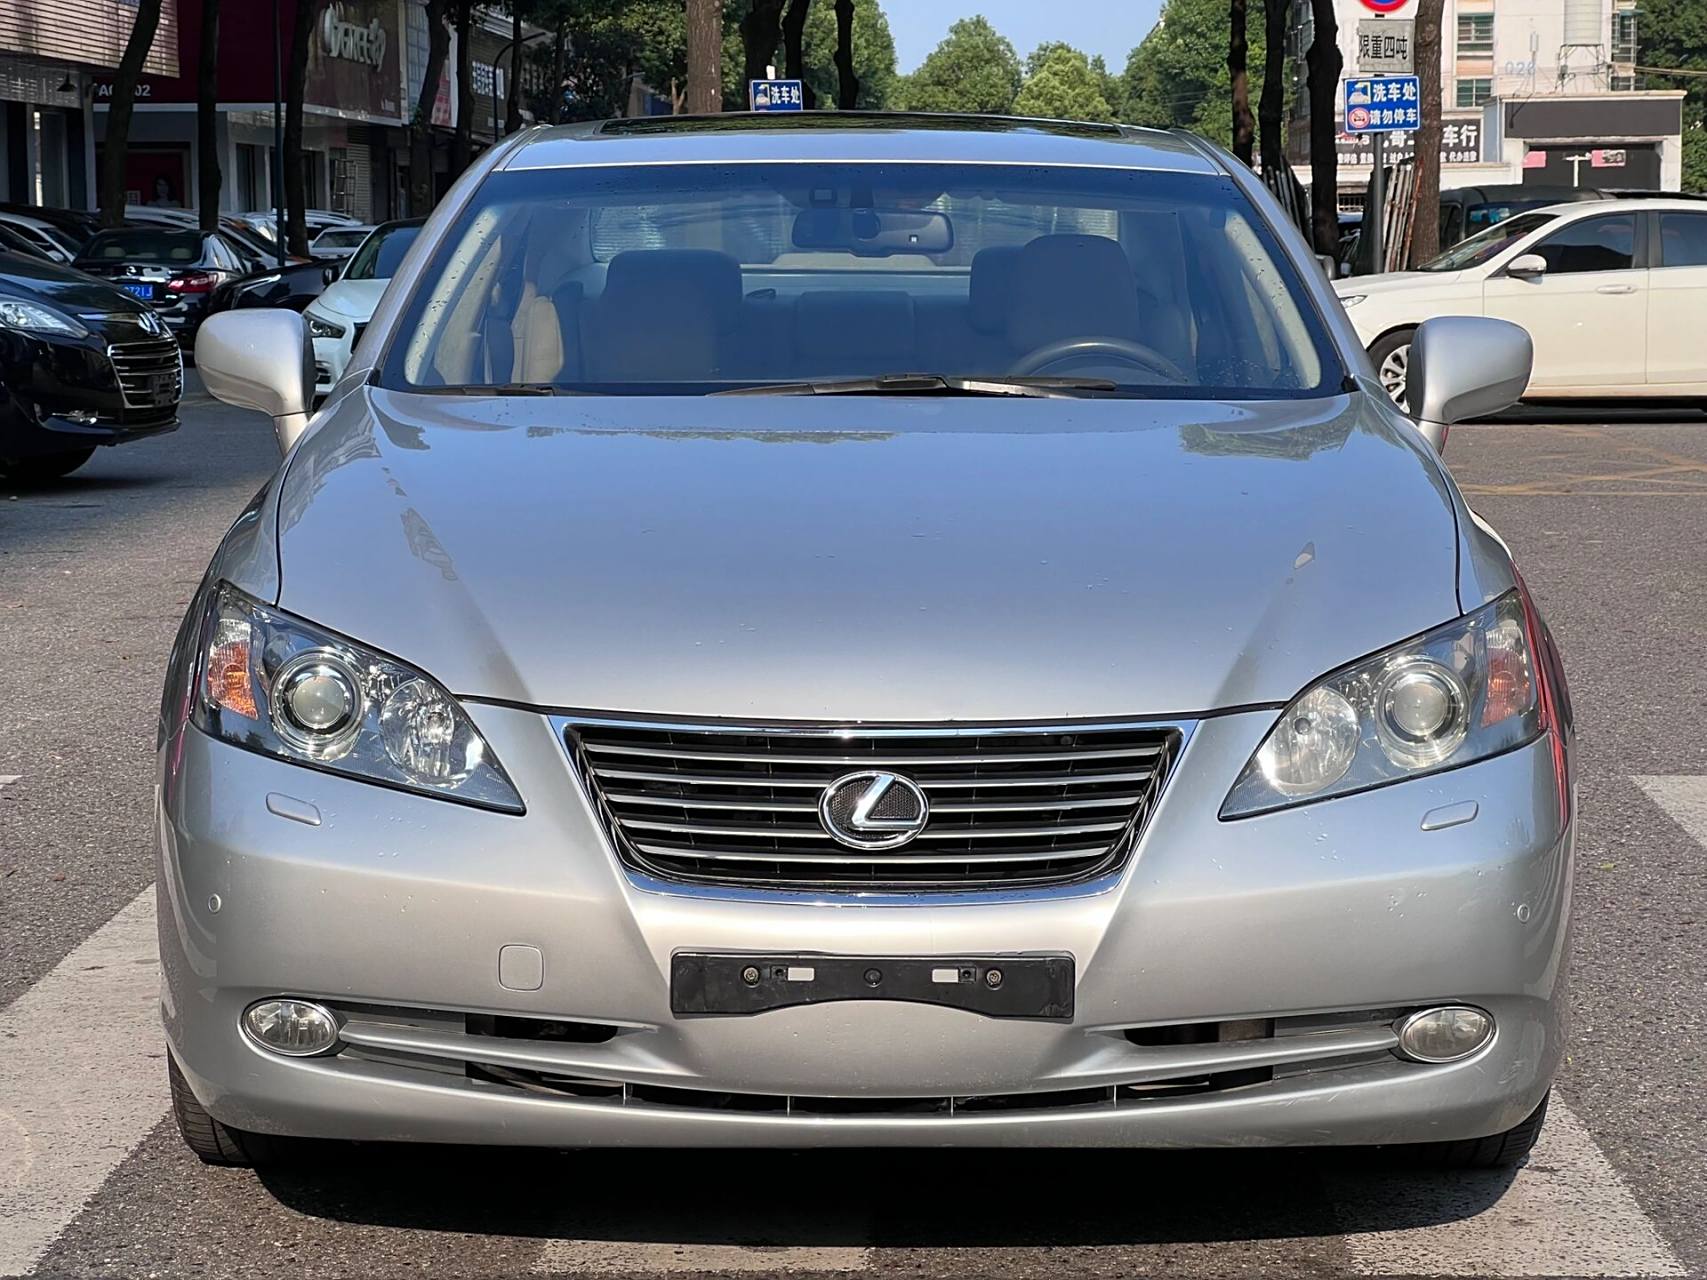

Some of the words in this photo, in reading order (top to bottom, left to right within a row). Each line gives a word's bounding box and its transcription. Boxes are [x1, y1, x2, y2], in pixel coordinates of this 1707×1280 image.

[1360, 34, 1408, 60] 限重四吨
[771, 85, 800, 104] 洗车处
[1373, 82, 1417, 102] 洗车处
[1370, 107, 1417, 125] 请勿停车
